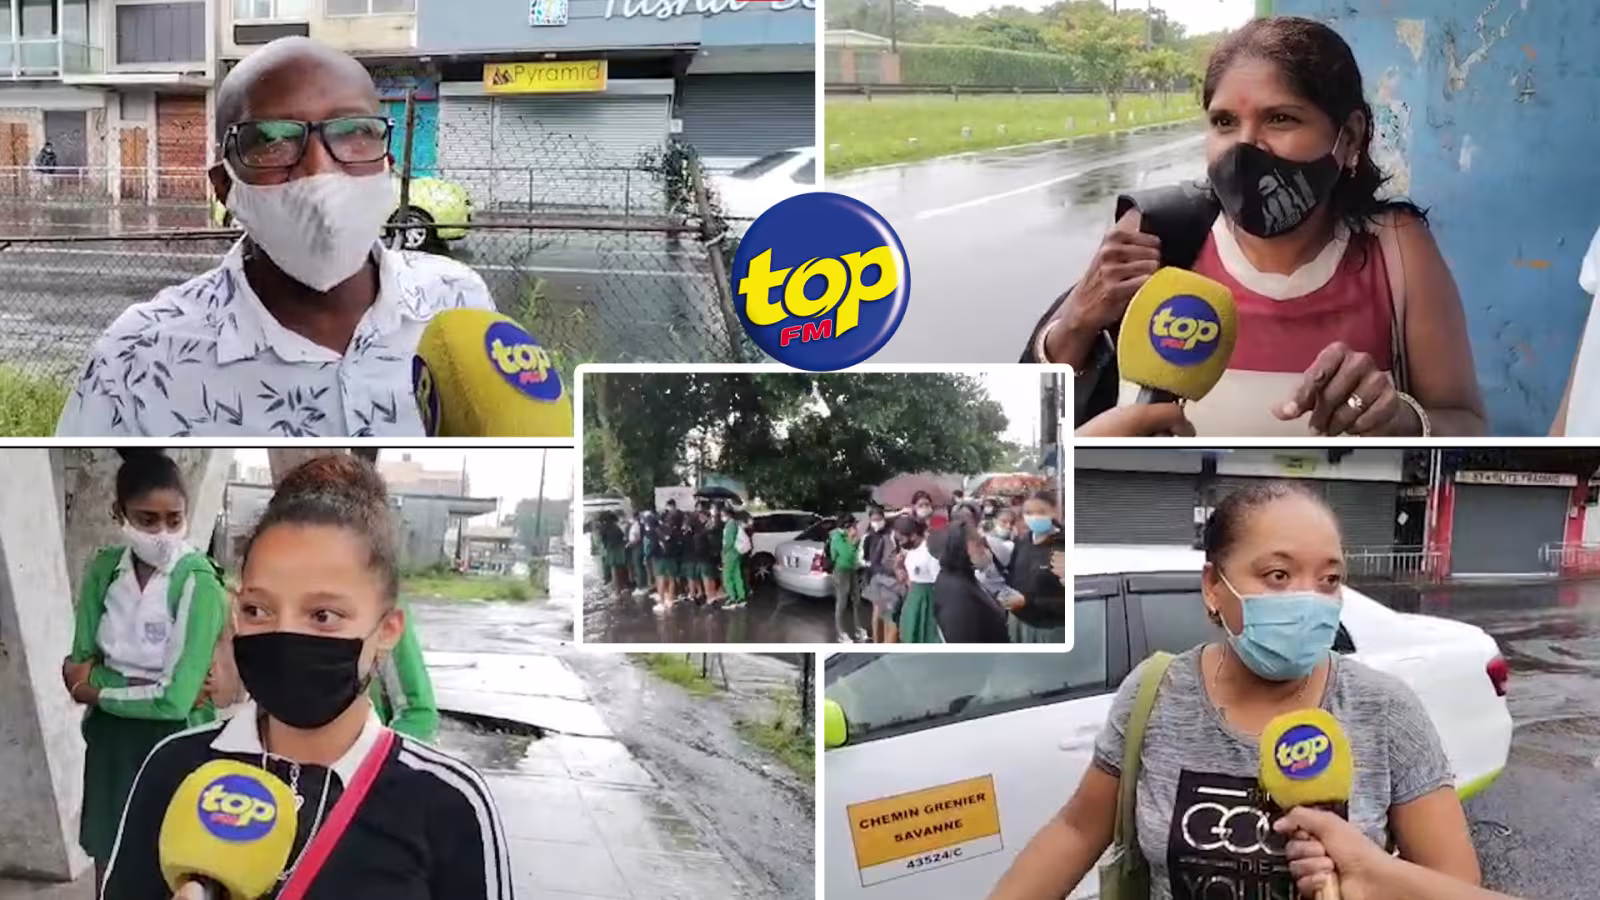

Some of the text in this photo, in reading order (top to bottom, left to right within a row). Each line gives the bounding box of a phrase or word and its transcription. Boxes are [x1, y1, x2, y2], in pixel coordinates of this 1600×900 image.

[514, 62, 601, 87] Pyramid
[1152, 307, 1219, 351] top
[492, 338, 551, 383] top
[1276, 734, 1330, 767] top
[201, 784, 276, 826] top
[859, 792, 986, 830] CHEMIN GRENIER
[894, 818, 964, 843] SAVANNE
[906, 847, 964, 870] 43524/C
